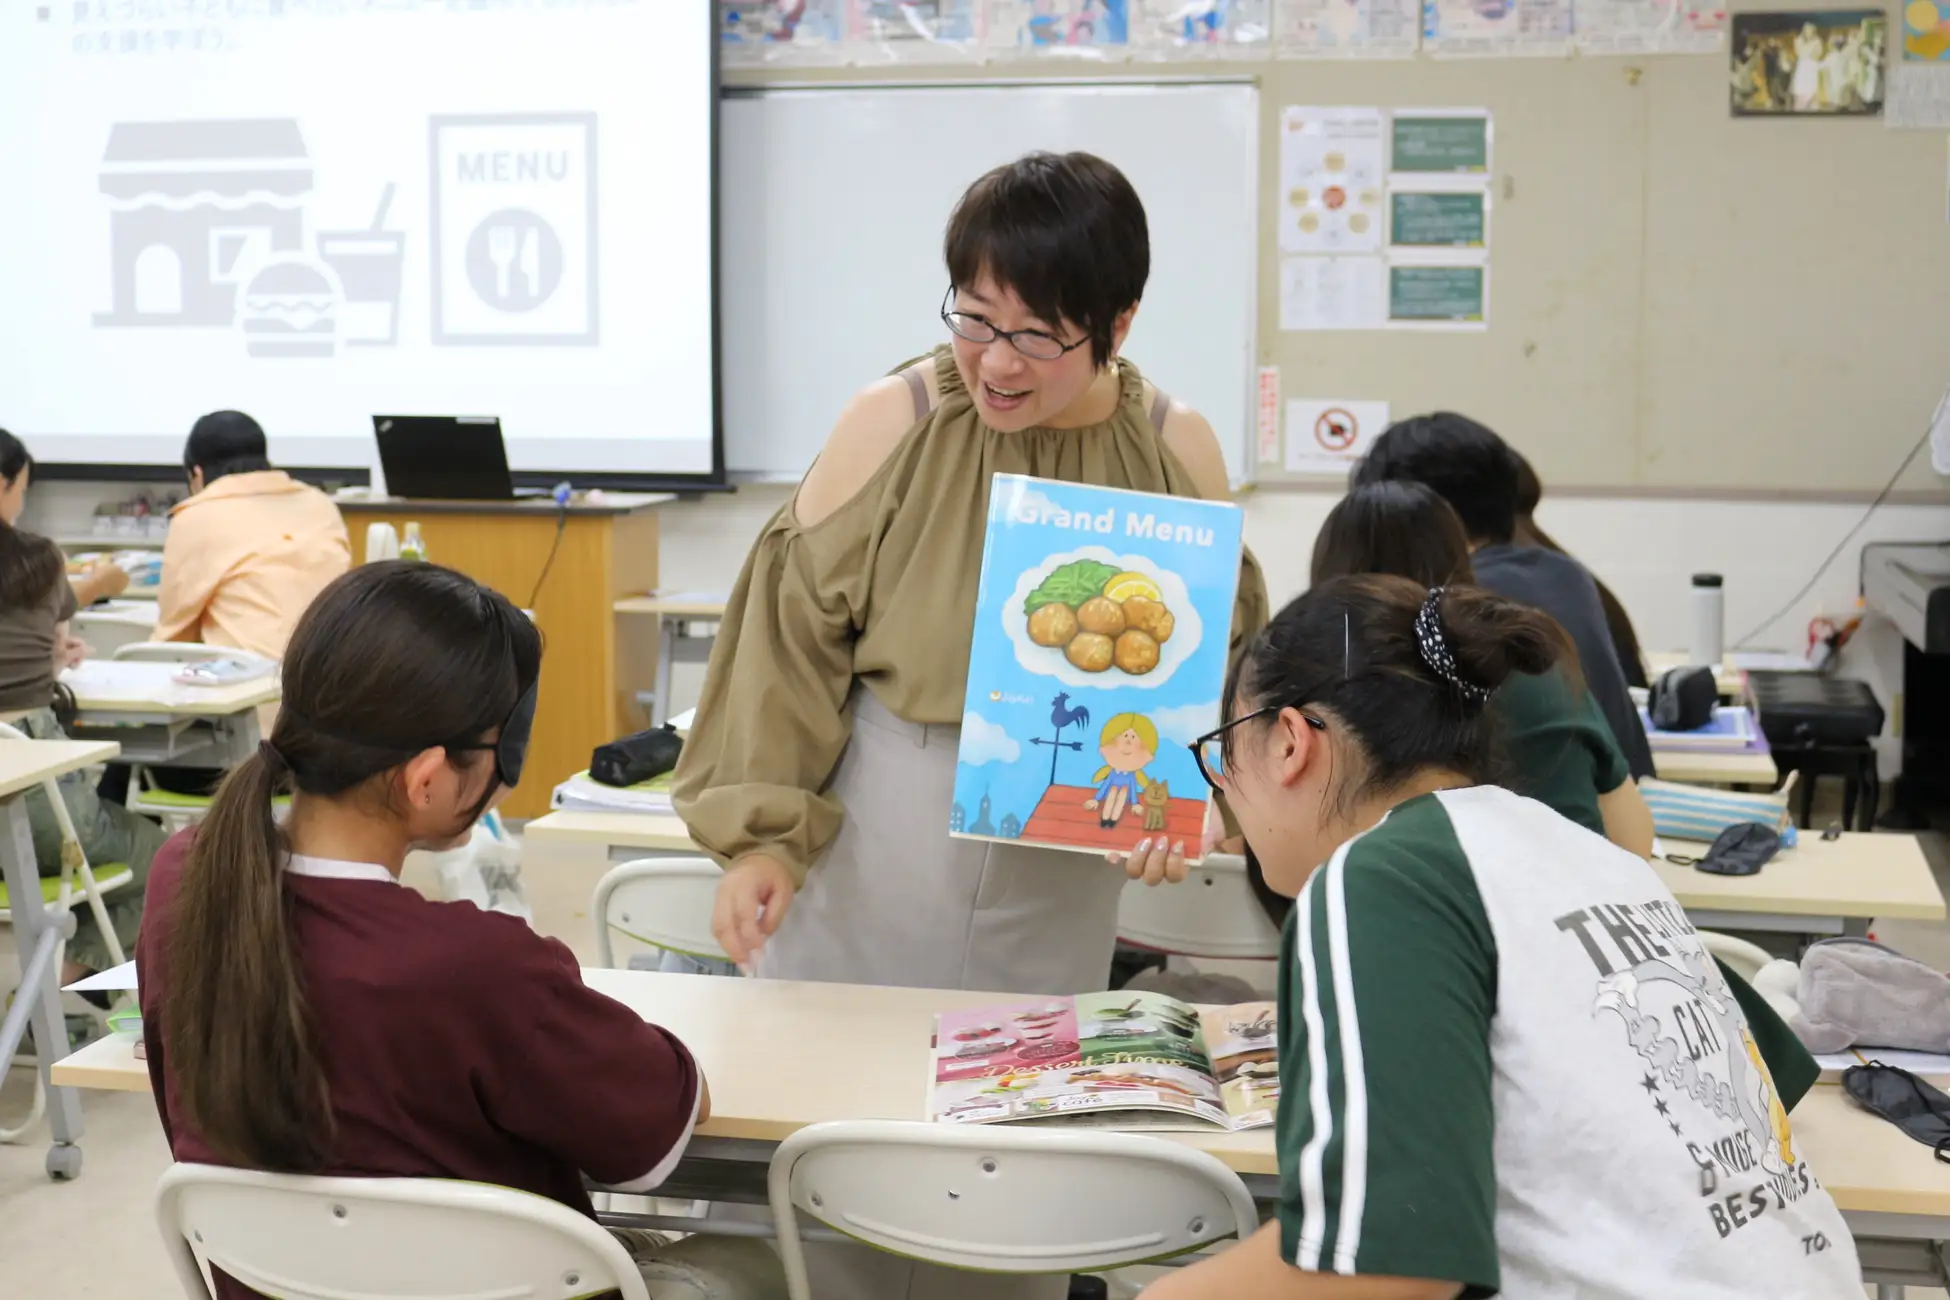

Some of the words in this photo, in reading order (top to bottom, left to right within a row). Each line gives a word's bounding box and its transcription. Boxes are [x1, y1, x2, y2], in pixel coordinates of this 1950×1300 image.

[457, 150, 569, 182] MENU
[1014, 500, 1115, 534] Grand
[1125, 511, 1215, 547] Menu
[1553, 903, 1671, 977] THE
[1673, 999, 1722, 1061] CAT
[985, 1055, 1097, 1077] Dessert
